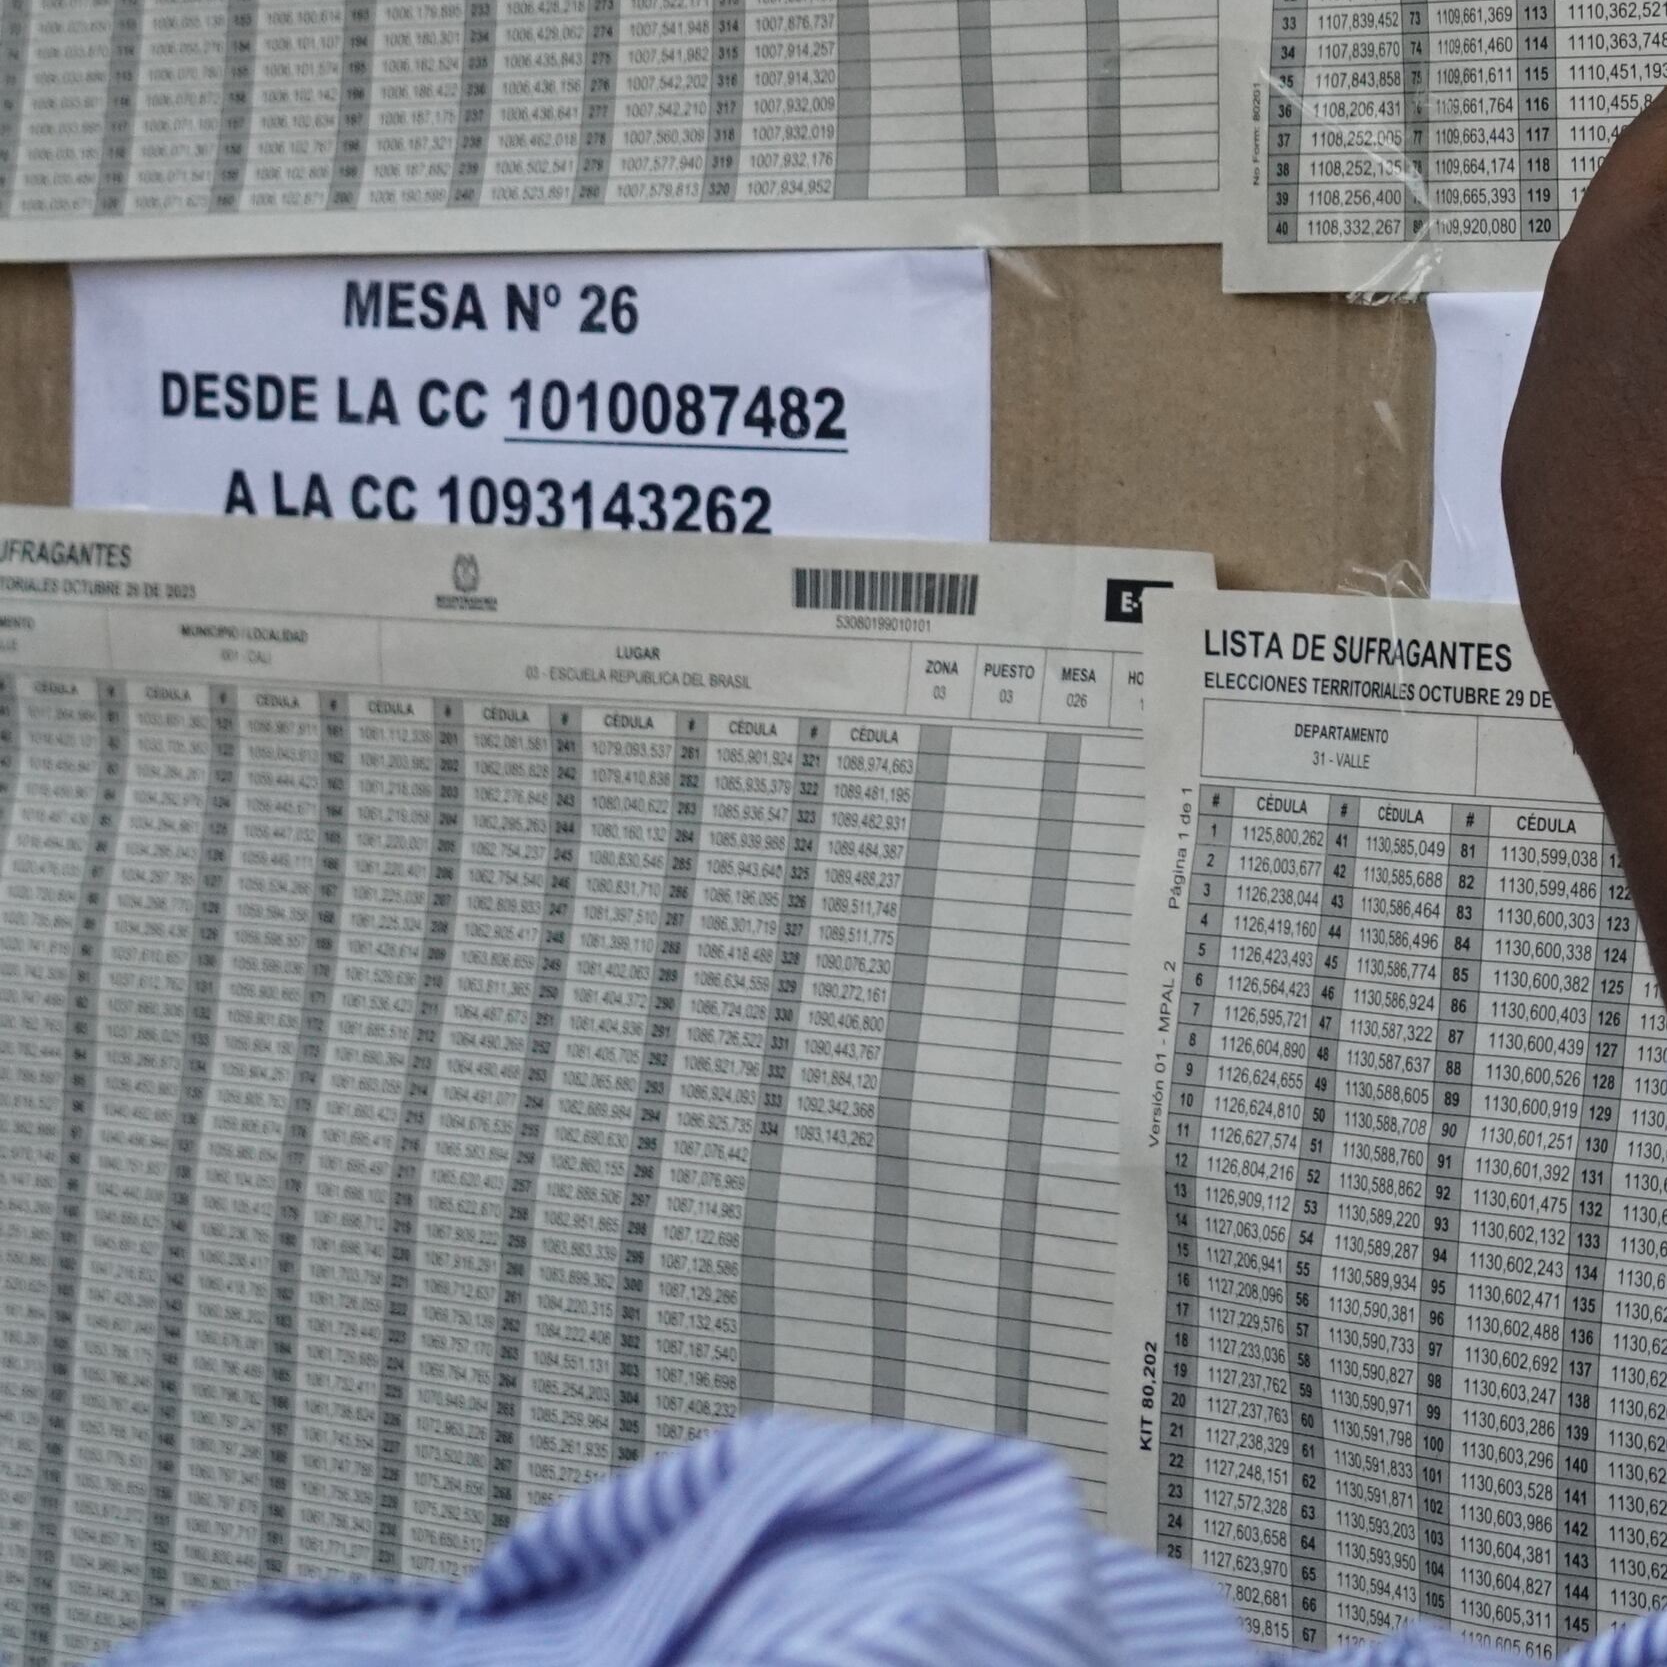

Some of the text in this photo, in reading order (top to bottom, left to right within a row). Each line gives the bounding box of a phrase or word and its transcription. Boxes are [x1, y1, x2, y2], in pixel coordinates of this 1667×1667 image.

[345, 281, 486, 330] MESA
[580, 285, 638, 334] 26
[162, 371, 846, 439] DESDE LA CC 1010087482
[225, 470, 771, 534] A LA CC 1093143262
[836, 616, 930, 632] 53080199010101
[1205, 629, 1512, 672] LISTA DE SUFRAGANTES
[1205, 671, 1553, 709] ELECCIONES TERRITORIALES OCTUBRE 29 DE
[1294, 723, 1388, 744] DEPARTAMENTO
[1461, 843, 1597, 868] 81 1130,599,038
[1140, 1341, 1158, 1451] KIT 80,202
